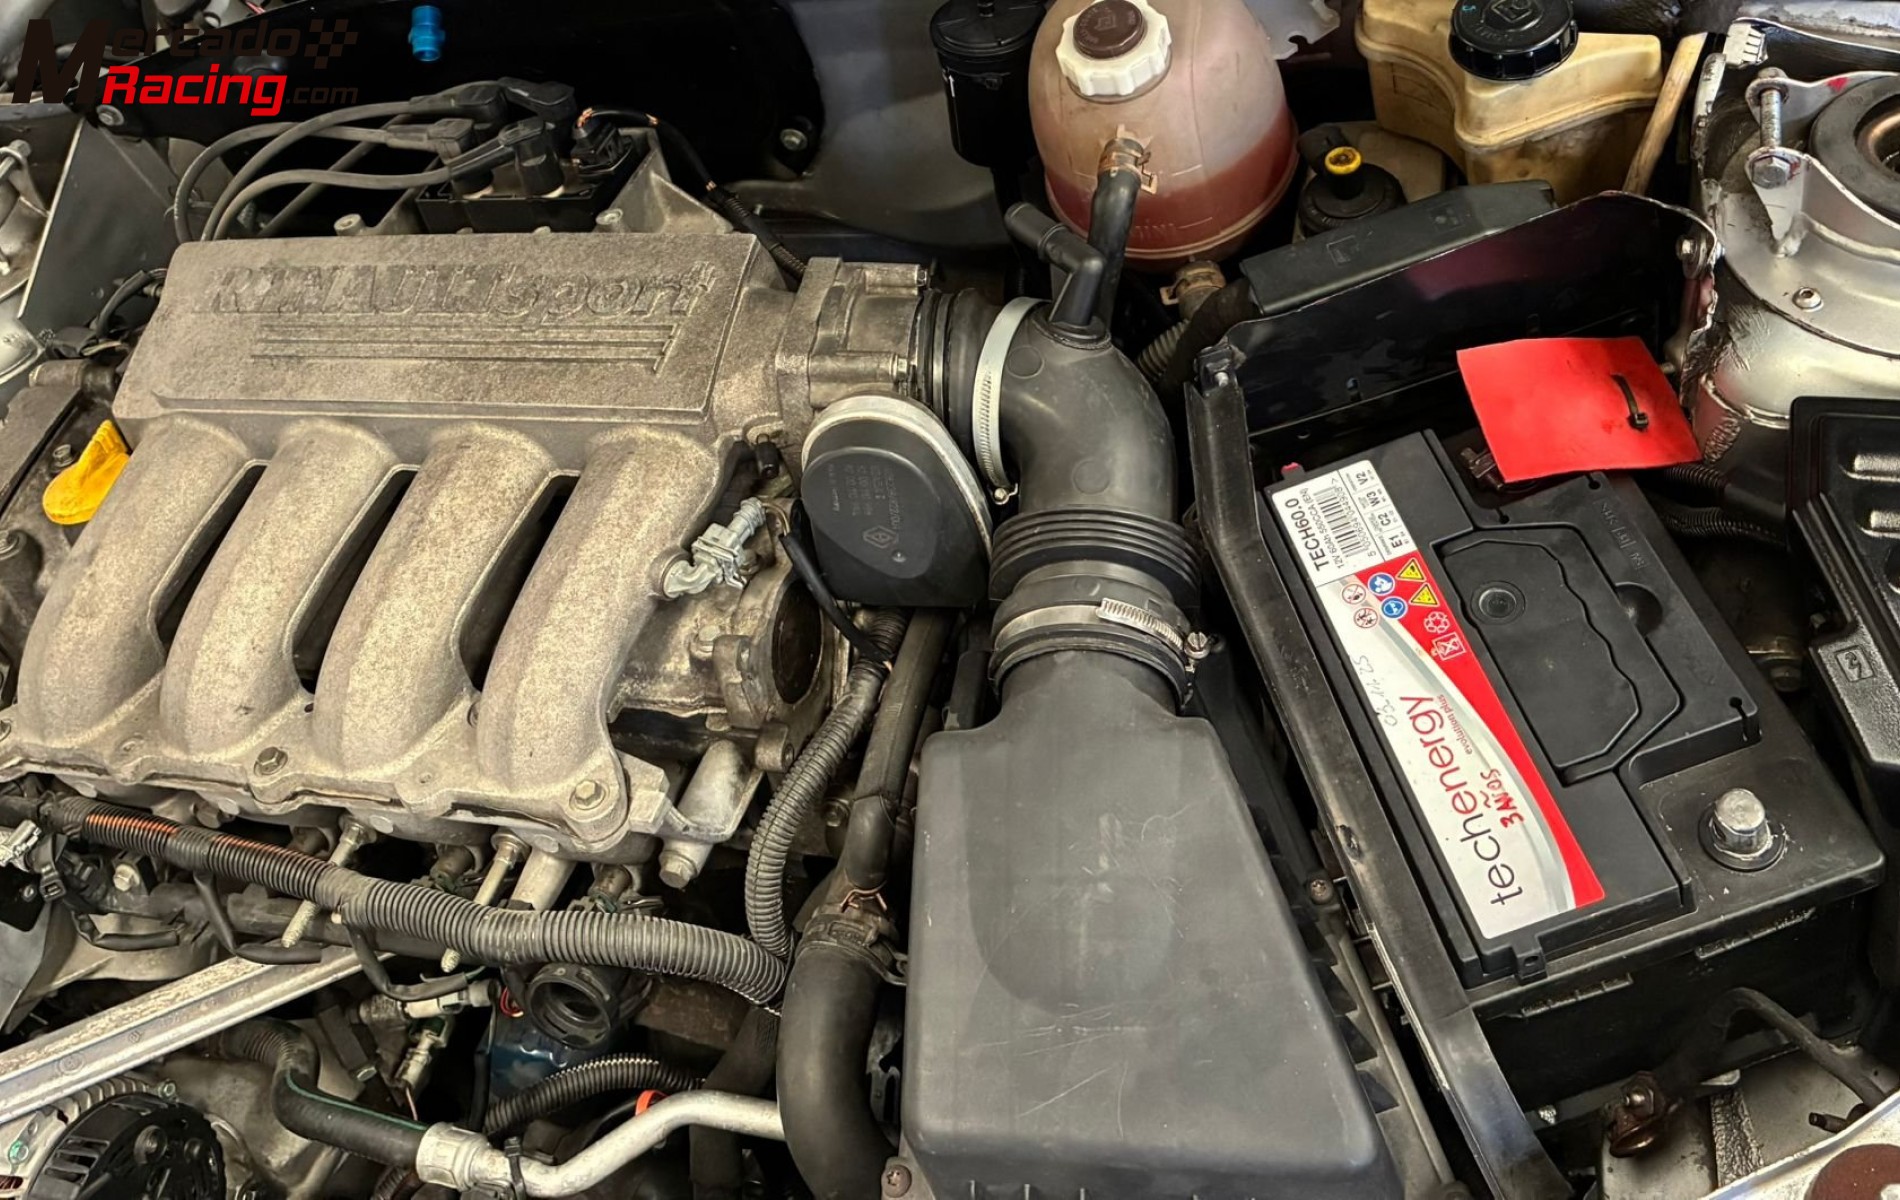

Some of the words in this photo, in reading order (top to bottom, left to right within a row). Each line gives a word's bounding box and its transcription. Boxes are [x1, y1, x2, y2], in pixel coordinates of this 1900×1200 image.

[1356, 471, 1368, 485] V2
[1366, 491, 1380, 507] W3
[1378, 513, 1391, 526] C2
[1285, 498, 1329, 571] TECH60.0
[1389, 535, 1403, 548] E1
[1332, 555, 1344, 569] 12V
[1437, 694, 1453, 713] plus
[1447, 713, 1473, 755] evolution
[1399, 696, 1523, 905] techenergy
